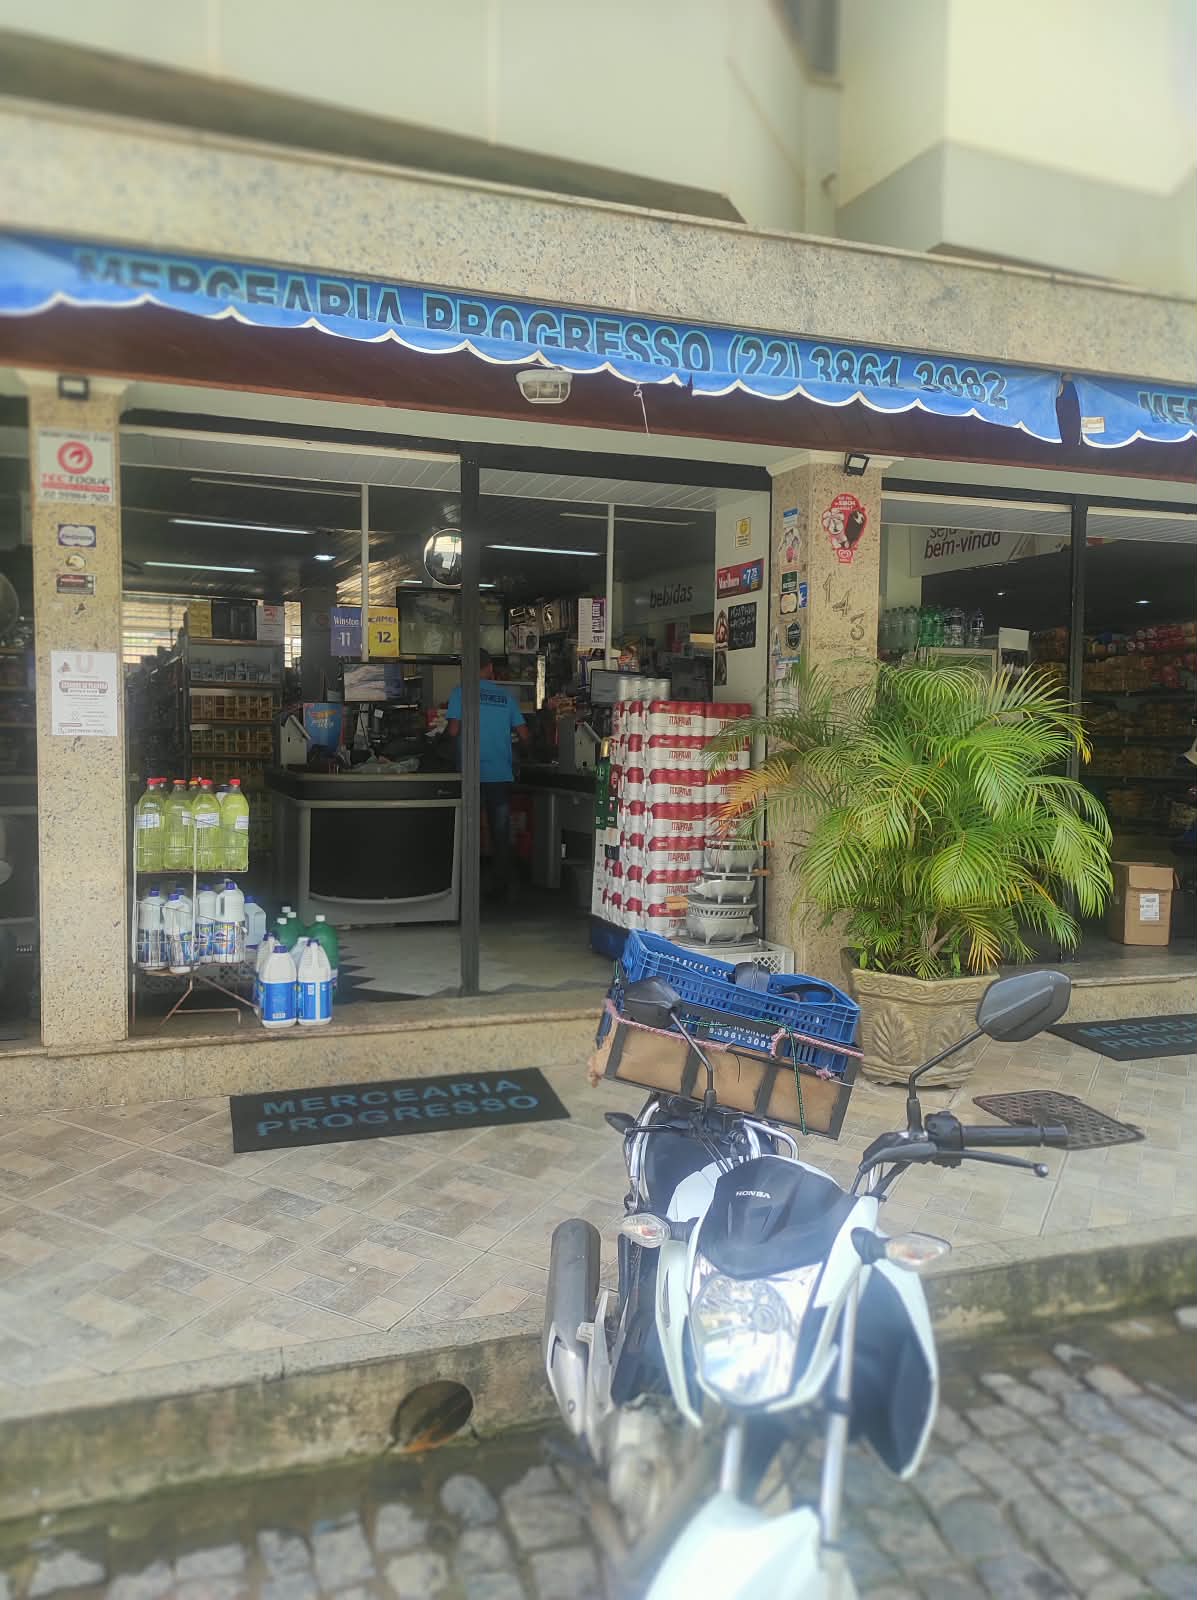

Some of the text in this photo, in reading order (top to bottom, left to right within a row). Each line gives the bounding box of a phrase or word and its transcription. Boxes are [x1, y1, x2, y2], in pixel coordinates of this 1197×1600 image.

[422, 292, 713, 373] PROGRESSO
[808, 345, 902, 388] 3861
[649, 583, 694, 609] bebidas
[377, 631, 392, 644] 12
[262, 1078, 522, 1116] MERCEARIA
[256, 1095, 539, 1137] PROGRESSO
[735, 1190, 771, 1199] HONDA
